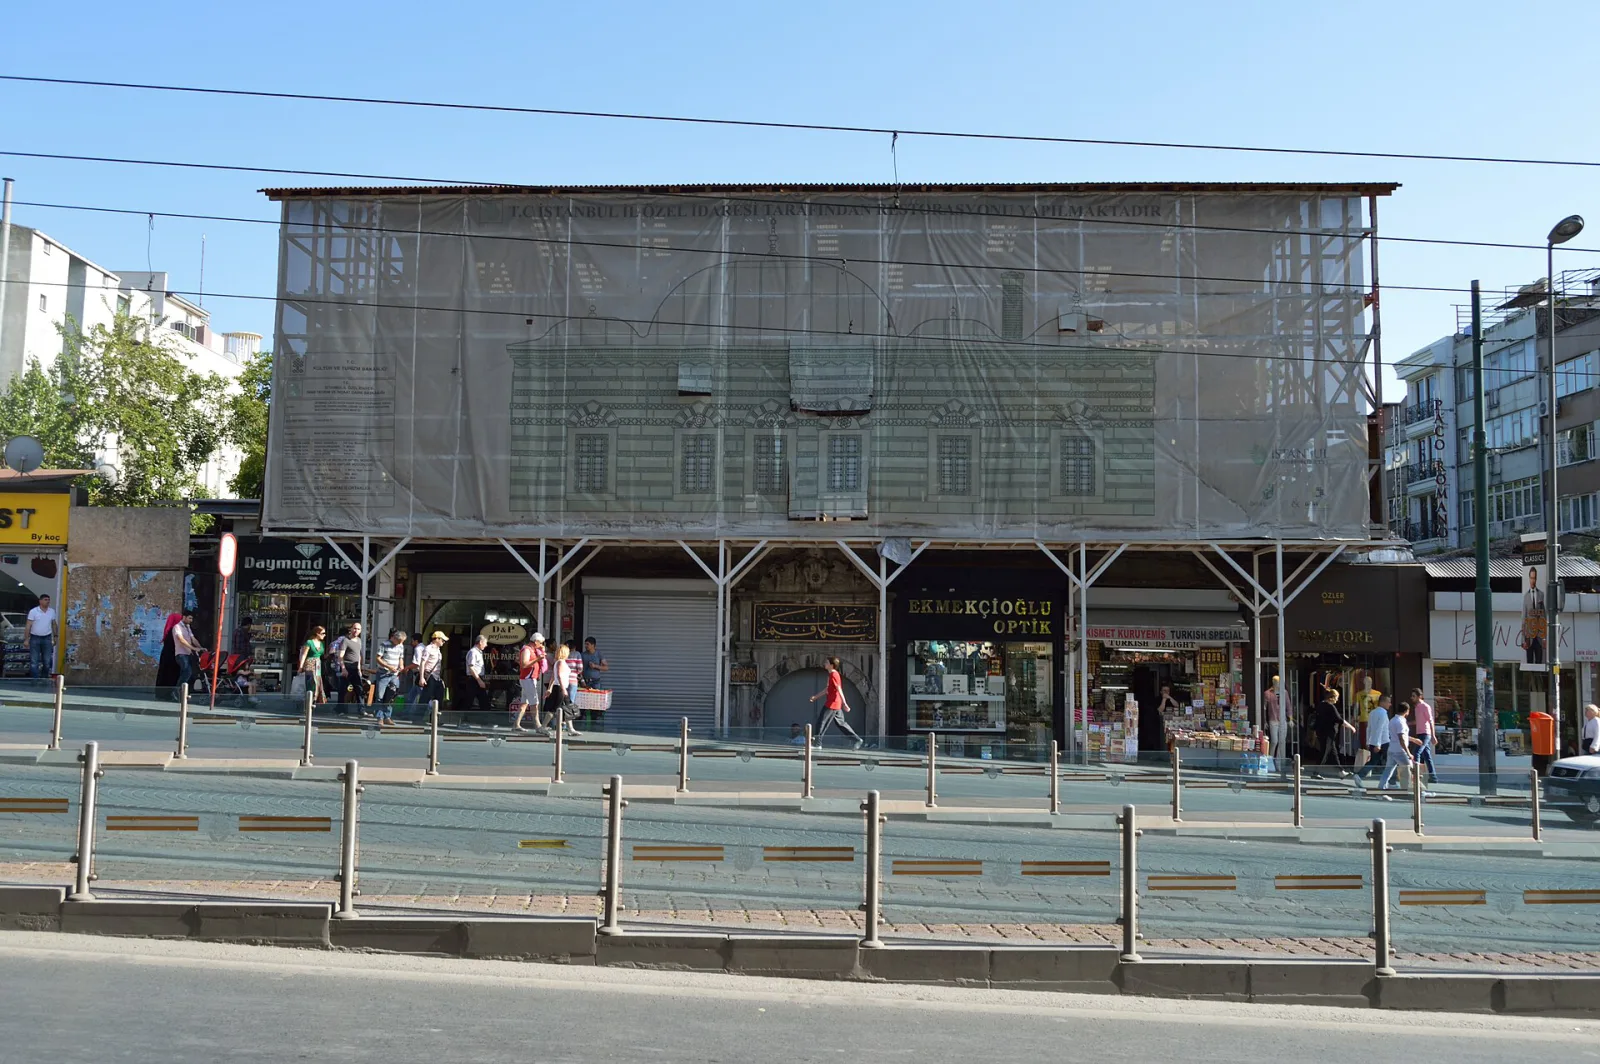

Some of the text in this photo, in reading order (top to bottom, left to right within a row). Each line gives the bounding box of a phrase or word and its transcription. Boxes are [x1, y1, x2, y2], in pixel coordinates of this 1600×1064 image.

[538, 203, 618, 218] İSTANBUL
[643, 202, 687, 218] ÖZEL
[692, 203, 758, 217] İDARESİ
[764, 202, 871, 217] TARAFINDAN
[1018, 203, 1162, 218] YAPILMAKTADIR
[1434, 399, 1449, 538] PACO ROMANO
[31, 533, 60, 542] By koç
[244, 556, 323, 571] Daymond
[1524, 554, 1545, 563] CLASSICS
[252, 578, 358, 591] Marmara Saat
[1321, 591, 1345, 599] ÖZLER
[908, 598, 1052, 619] EKMEKÇİOĞLU
[993, 618, 1052, 634] OPTİK
[1461, 620, 1512, 646] EİN
[1086, 628, 1116, 638] KISMET
[1170, 630, 1207, 640] TURKISH
[1155, 641, 1196, 649] DELIGHT
